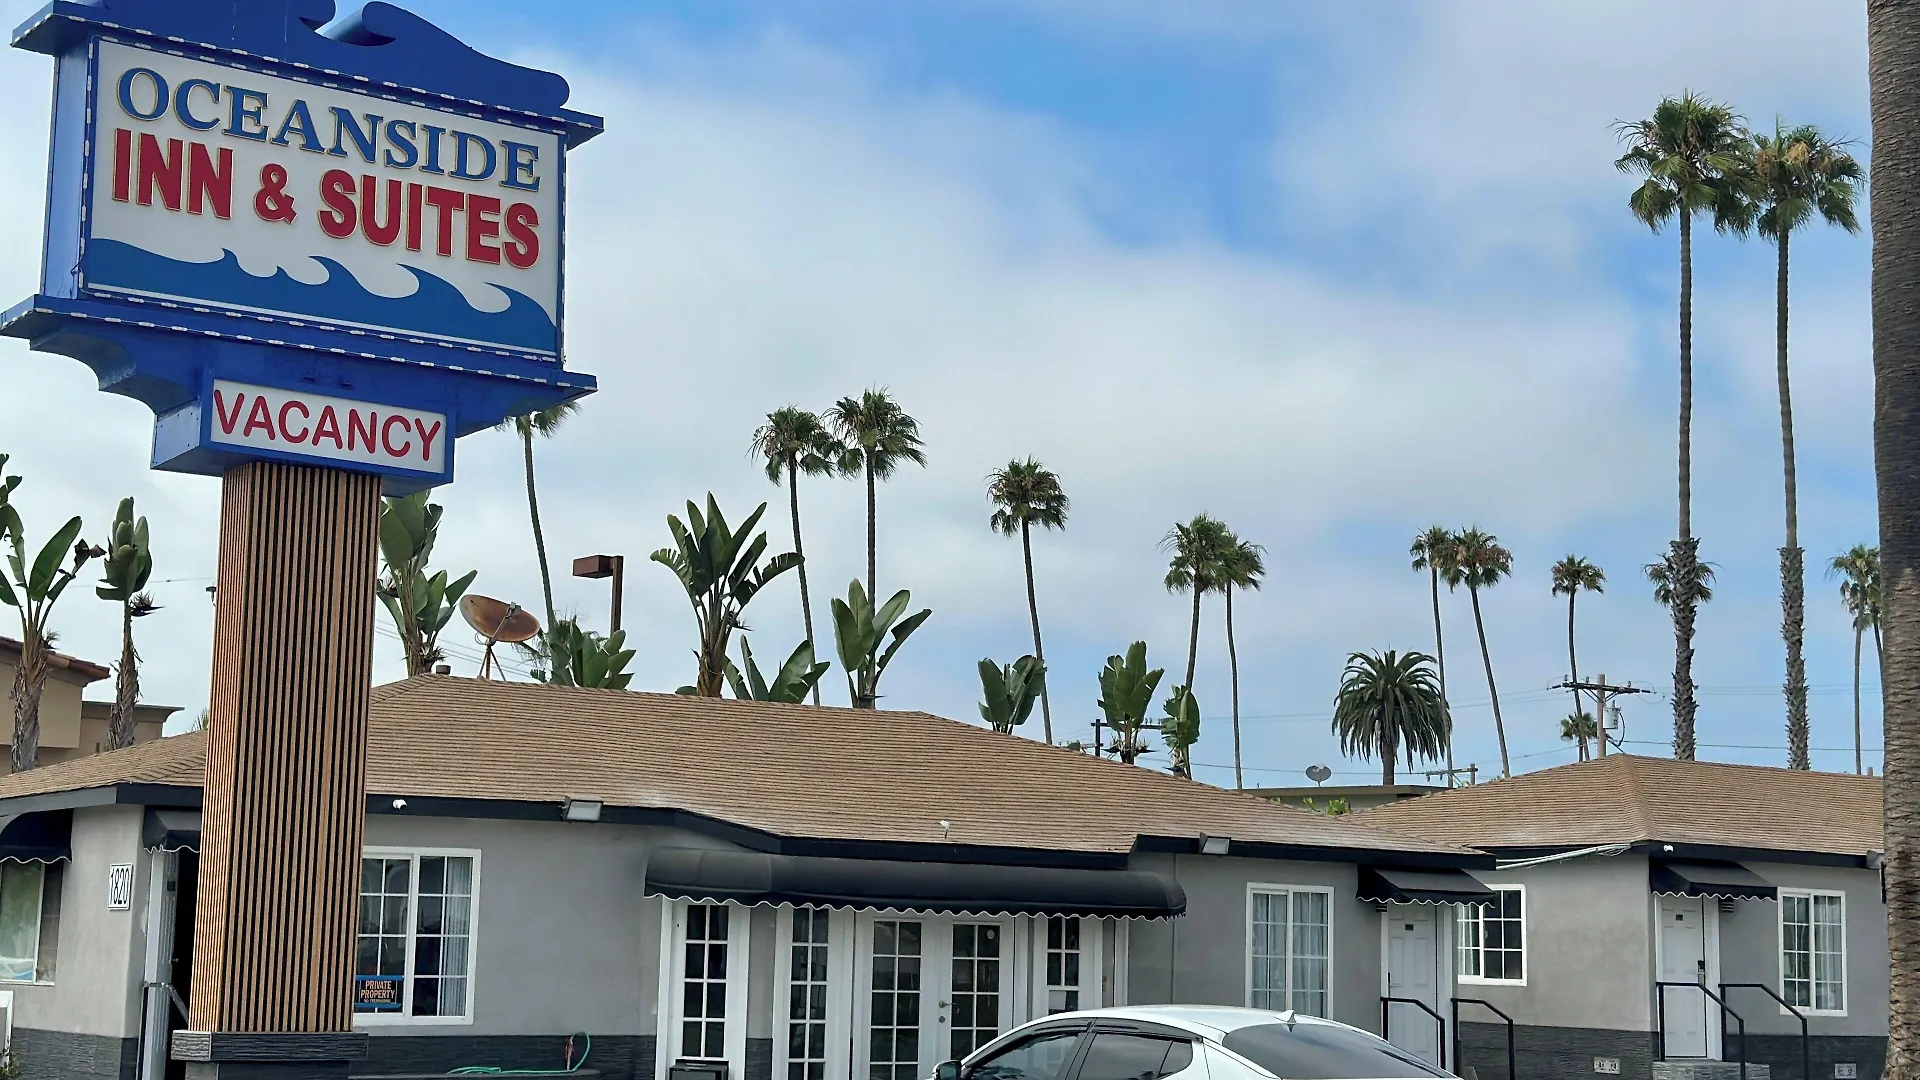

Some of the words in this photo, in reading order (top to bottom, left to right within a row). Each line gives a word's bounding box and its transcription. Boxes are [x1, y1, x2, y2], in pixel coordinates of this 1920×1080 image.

[116, 67, 541, 191] OCEANSIDE
[112, 128, 234, 219] INN
[254, 163, 297, 223] &
[318, 168, 541, 269] SUITES
[213, 389, 441, 461] VACANCY
[109, 867, 130, 905] 1820
[360, 989, 396, 999] PROPERTY
[365, 980, 392, 990] PRIVATE
